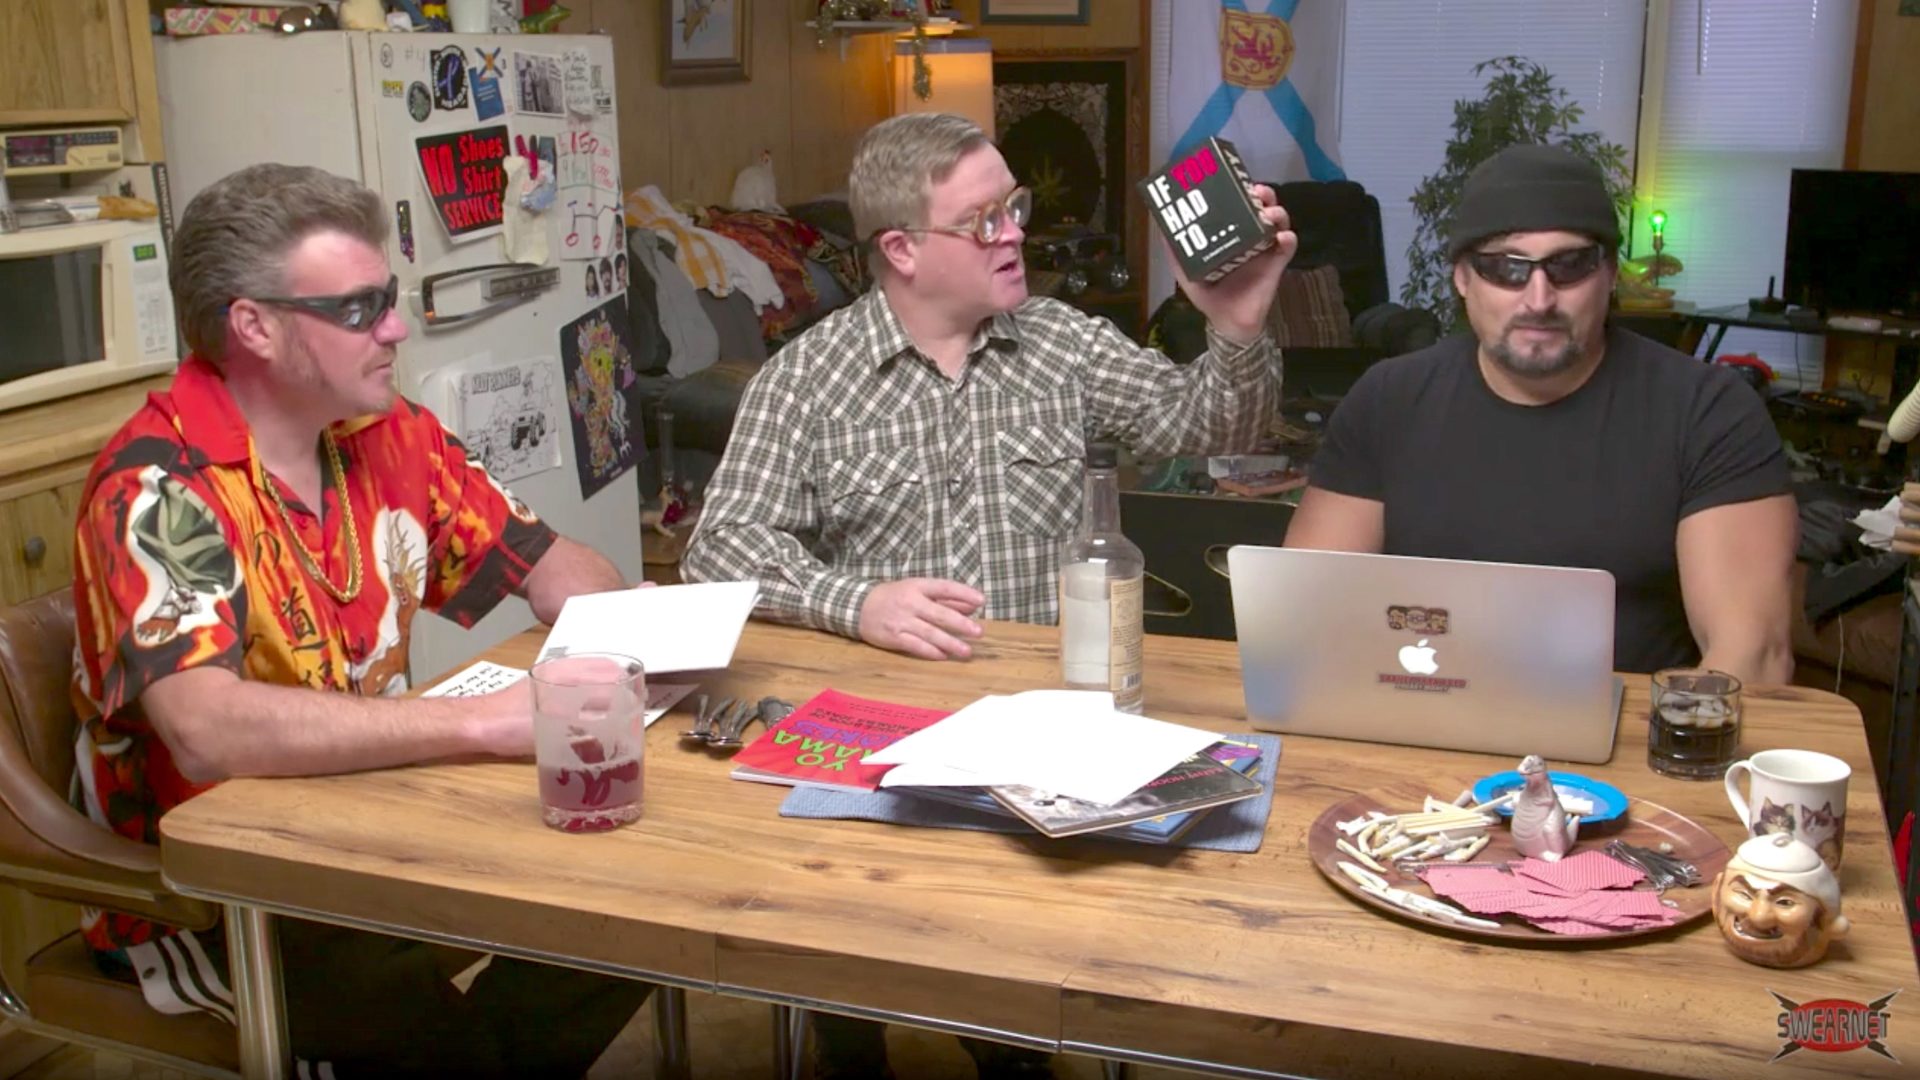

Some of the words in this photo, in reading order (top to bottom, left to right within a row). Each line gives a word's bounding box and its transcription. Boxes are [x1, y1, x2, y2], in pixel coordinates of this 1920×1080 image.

[420, 144, 457, 197] NO
[459, 134, 503, 163] Shoes
[463, 165, 502, 195] Shirt
[1147, 174, 1172, 209] IF
[1170, 147, 1219, 191] YOU
[443, 193, 502, 230] SERVICE
[1160, 188, 1209, 234] HAD
[795, 752, 849, 771] YO
